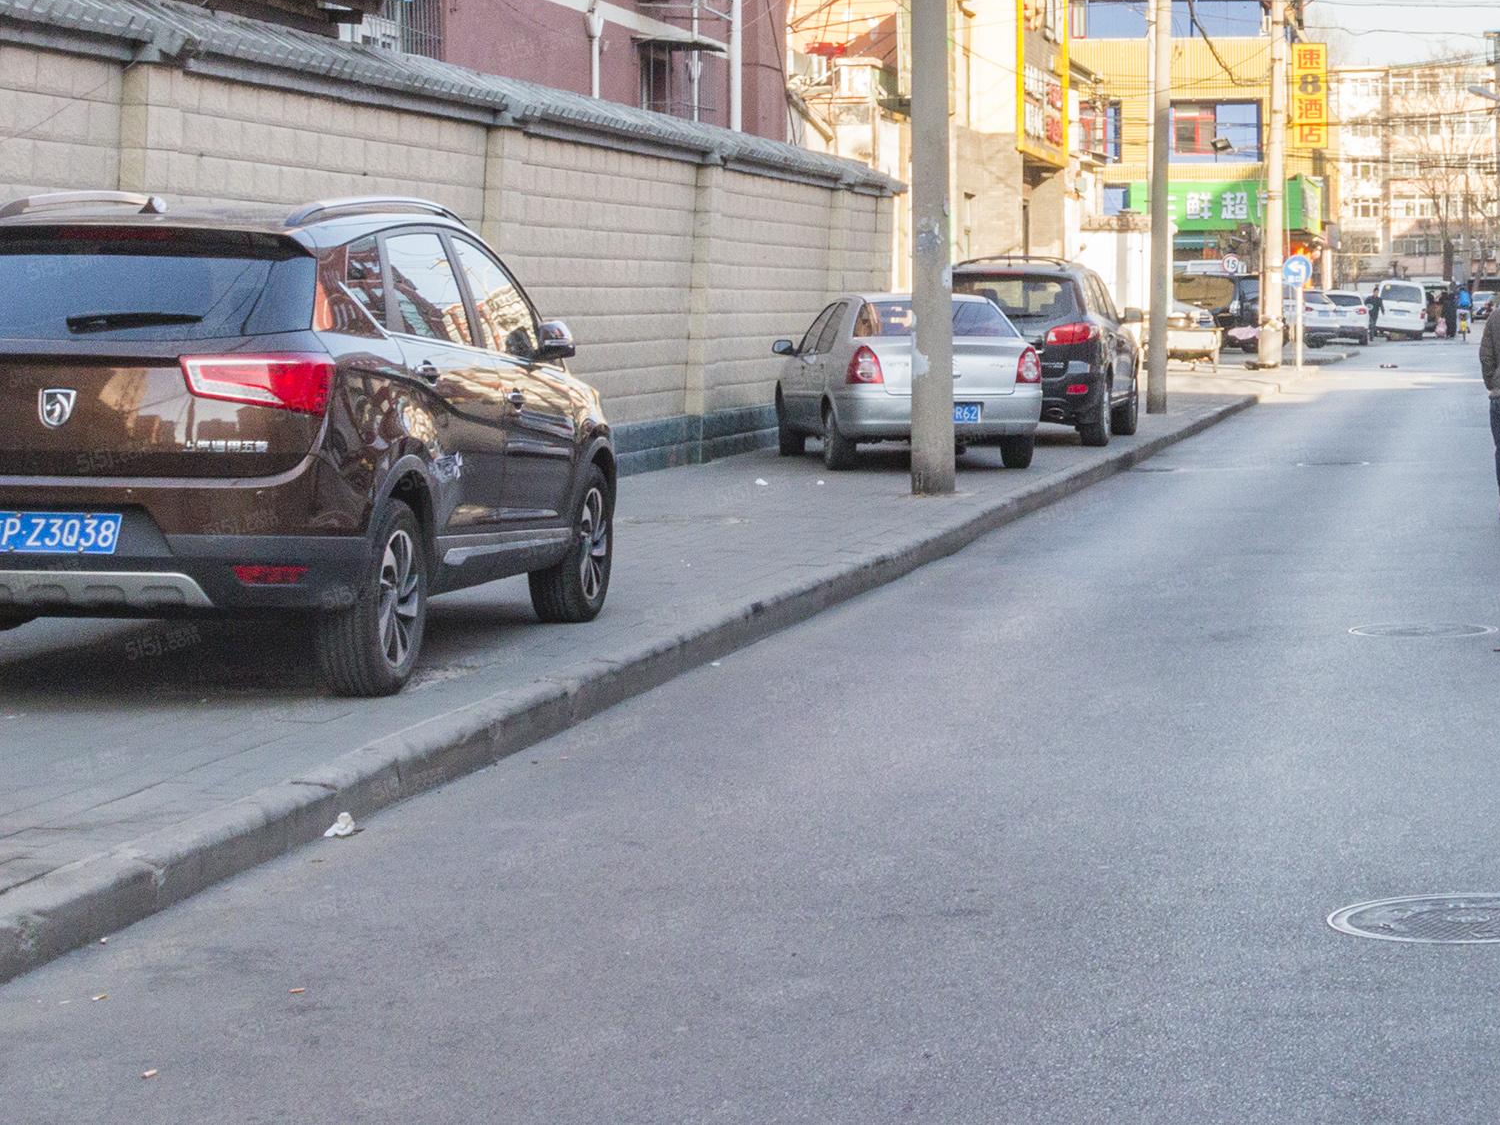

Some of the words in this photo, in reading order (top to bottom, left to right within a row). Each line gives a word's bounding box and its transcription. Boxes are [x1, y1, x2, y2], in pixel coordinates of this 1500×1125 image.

[1297, 48, 1322, 143] 速8酒店
[1226, 259, 1237, 269] 15
[0, 517, 116, 549] P·Z3Q38
